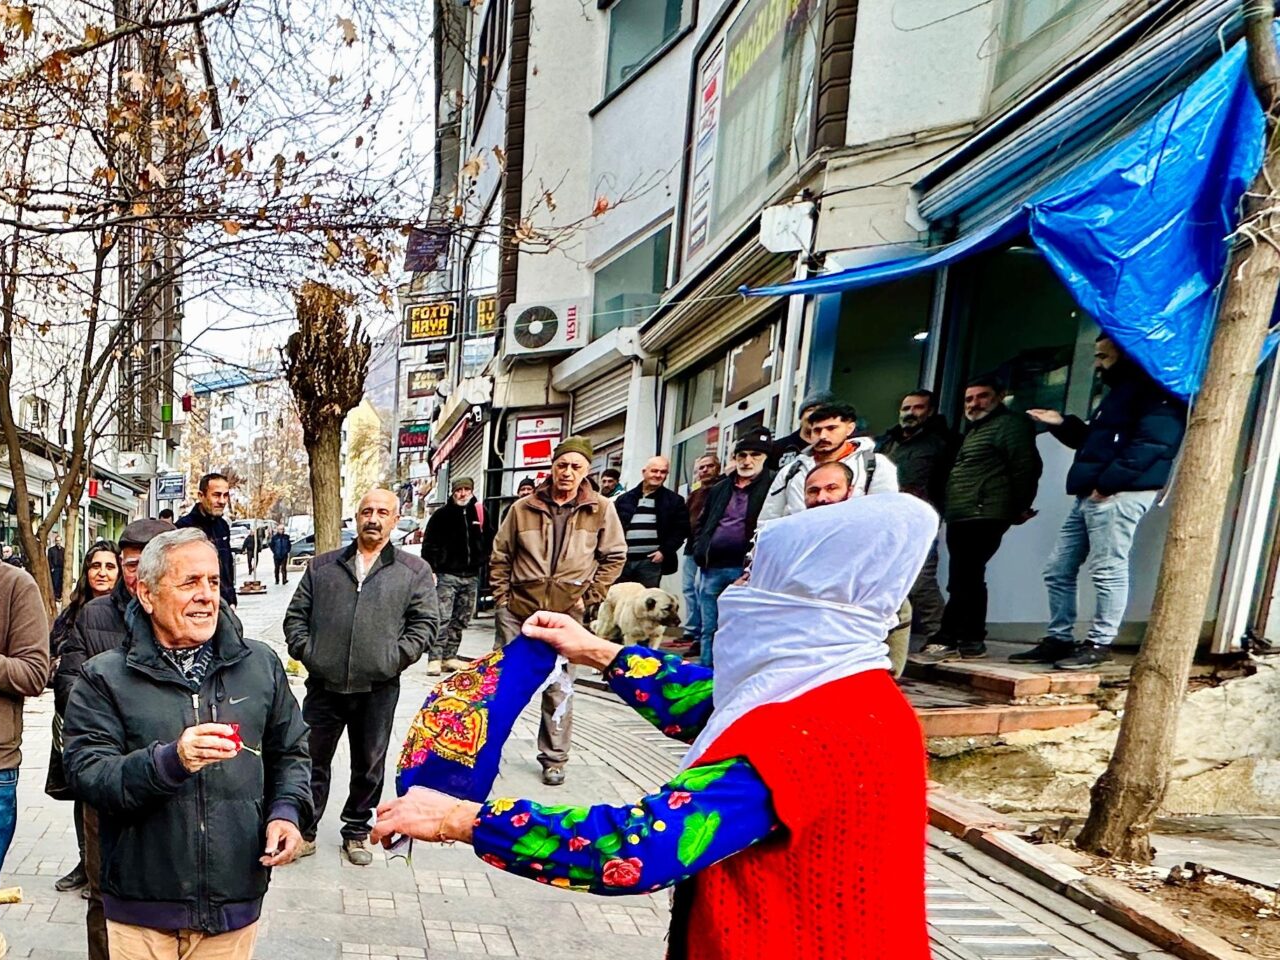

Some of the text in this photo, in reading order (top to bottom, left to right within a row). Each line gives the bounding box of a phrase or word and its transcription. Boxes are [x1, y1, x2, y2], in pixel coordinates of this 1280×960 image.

[411, 304, 450, 320] FOTO
[566, 305, 577, 341] VESTEL
[412, 381, 439, 390] Kay
